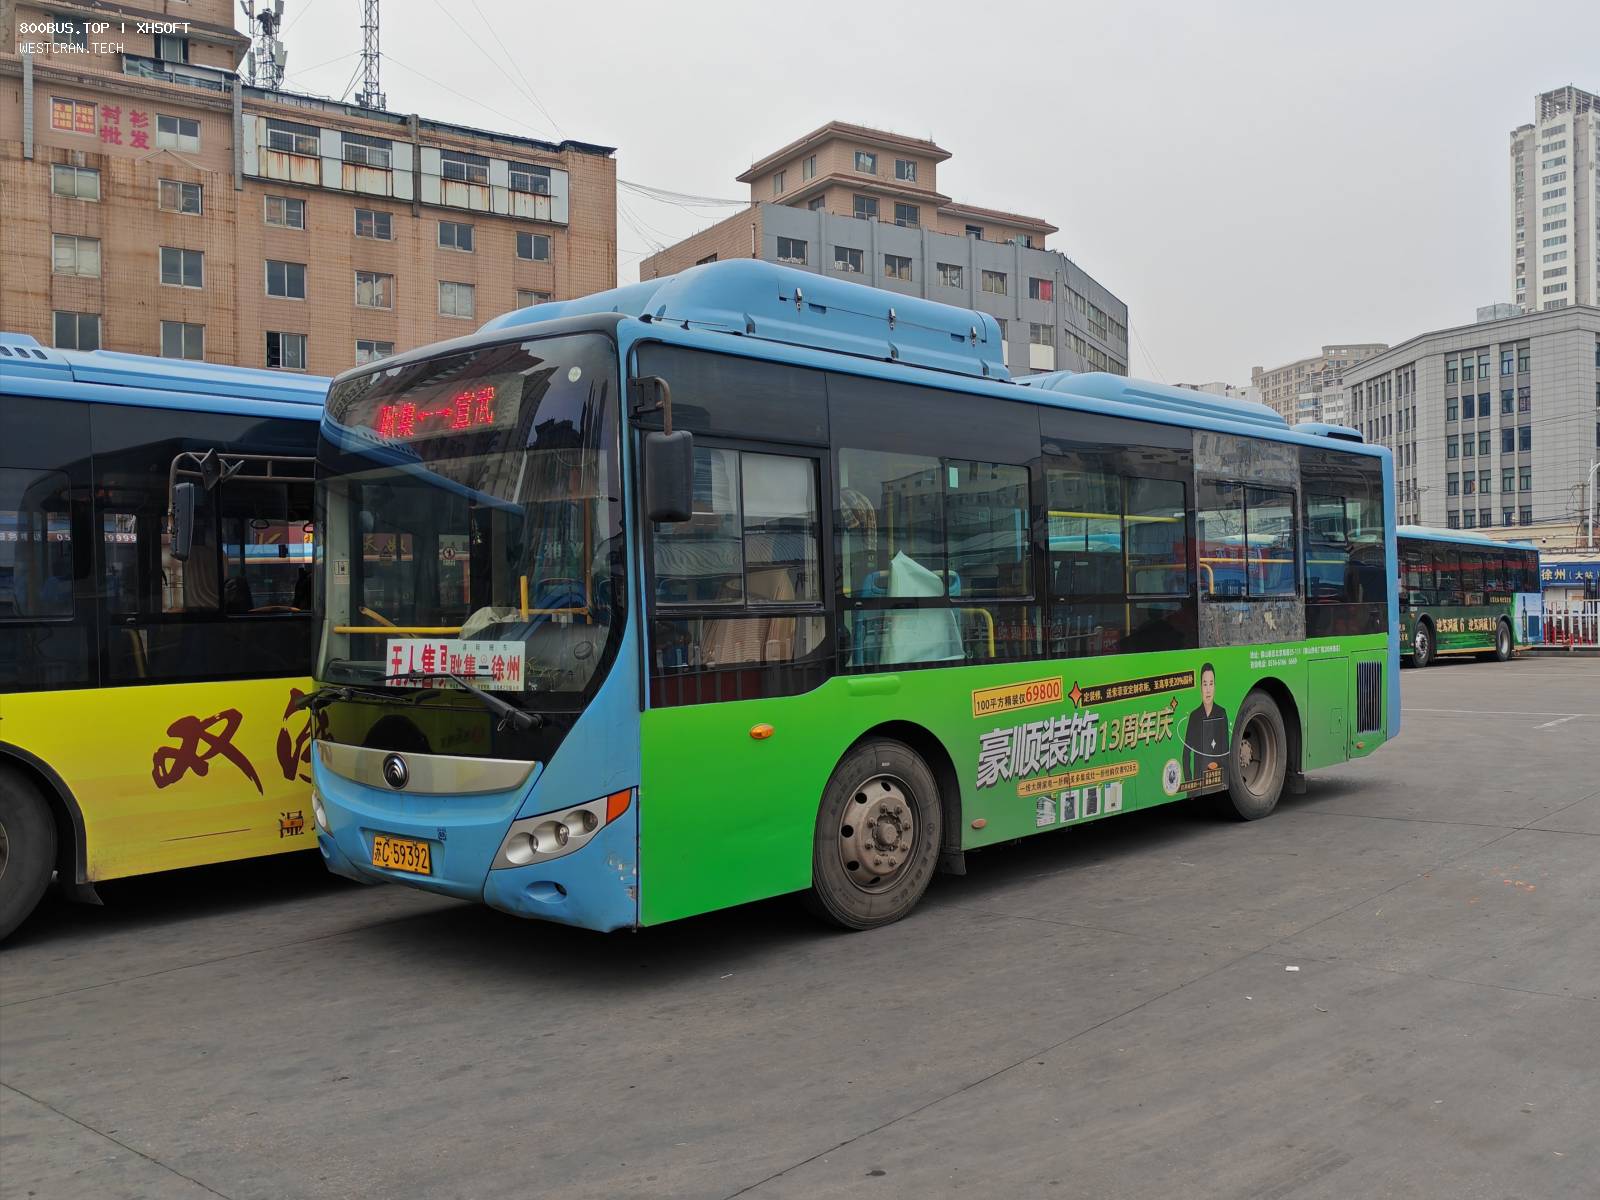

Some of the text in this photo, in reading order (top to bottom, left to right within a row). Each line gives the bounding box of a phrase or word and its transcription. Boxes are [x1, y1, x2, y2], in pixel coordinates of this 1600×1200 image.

[101, 104, 150, 129] 衬衫
[100, 125, 150, 149] 批发
[976, 708, 1175, 788] 豪顺装饰 13周年庆
